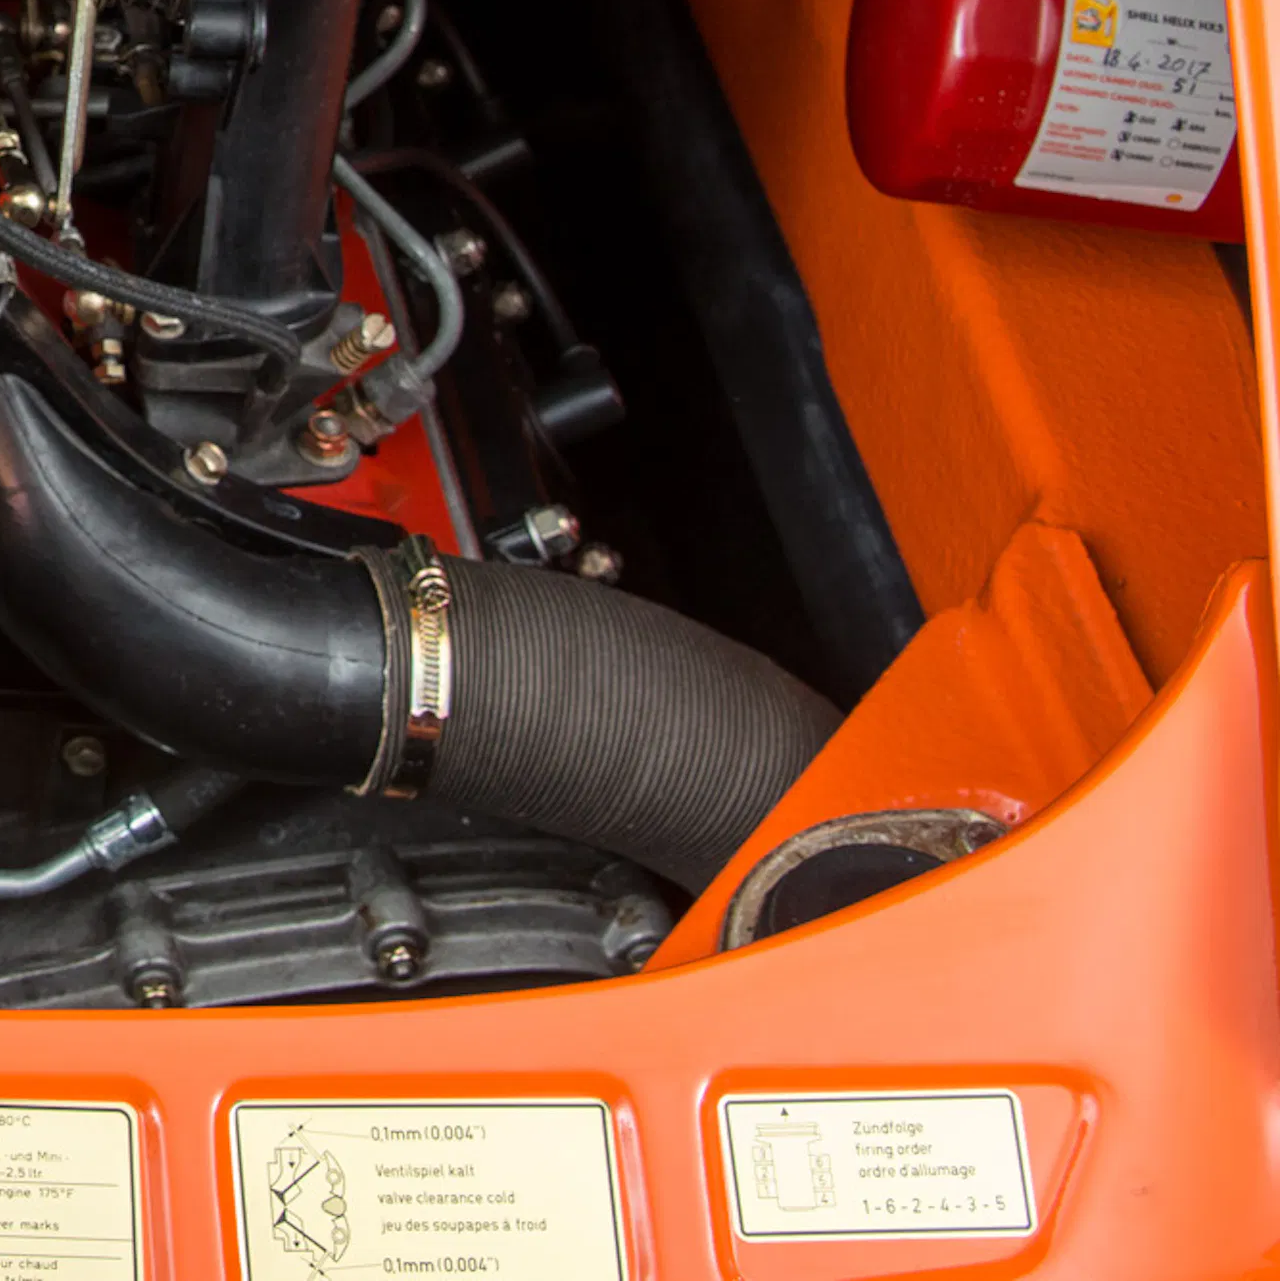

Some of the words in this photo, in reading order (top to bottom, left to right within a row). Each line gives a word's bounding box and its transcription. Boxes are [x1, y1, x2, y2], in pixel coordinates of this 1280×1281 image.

[1127, 9, 1159, 24] SHELL
[1162, 14, 1196, 29] HELIX
[855, 1142, 893, 1159] firing
[897, 1142, 932, 1156] order
[374, 1163, 445, 1180] Ventilspiel
[448, 1163, 475, 1178] kalt
[858, 1164, 896, 1179] ordre
[899, 1163, 976, 1181] d'allumage
[39, 1187, 76, 1200] 175°F
[377, 1191, 412, 1205] valve
[415, 1191, 483, 1205] clearance
[486, 1190, 515, 1205] cold
[20, 1219, 60, 1231] marks
[381, 1216, 402, 1235] jeu
[405, 1218, 429, 1232] des
[432, 1220, 499, 1235] soupapes
[515, 1217, 548, 1232] froid
[18, 1258, 58, 1271] chaud
